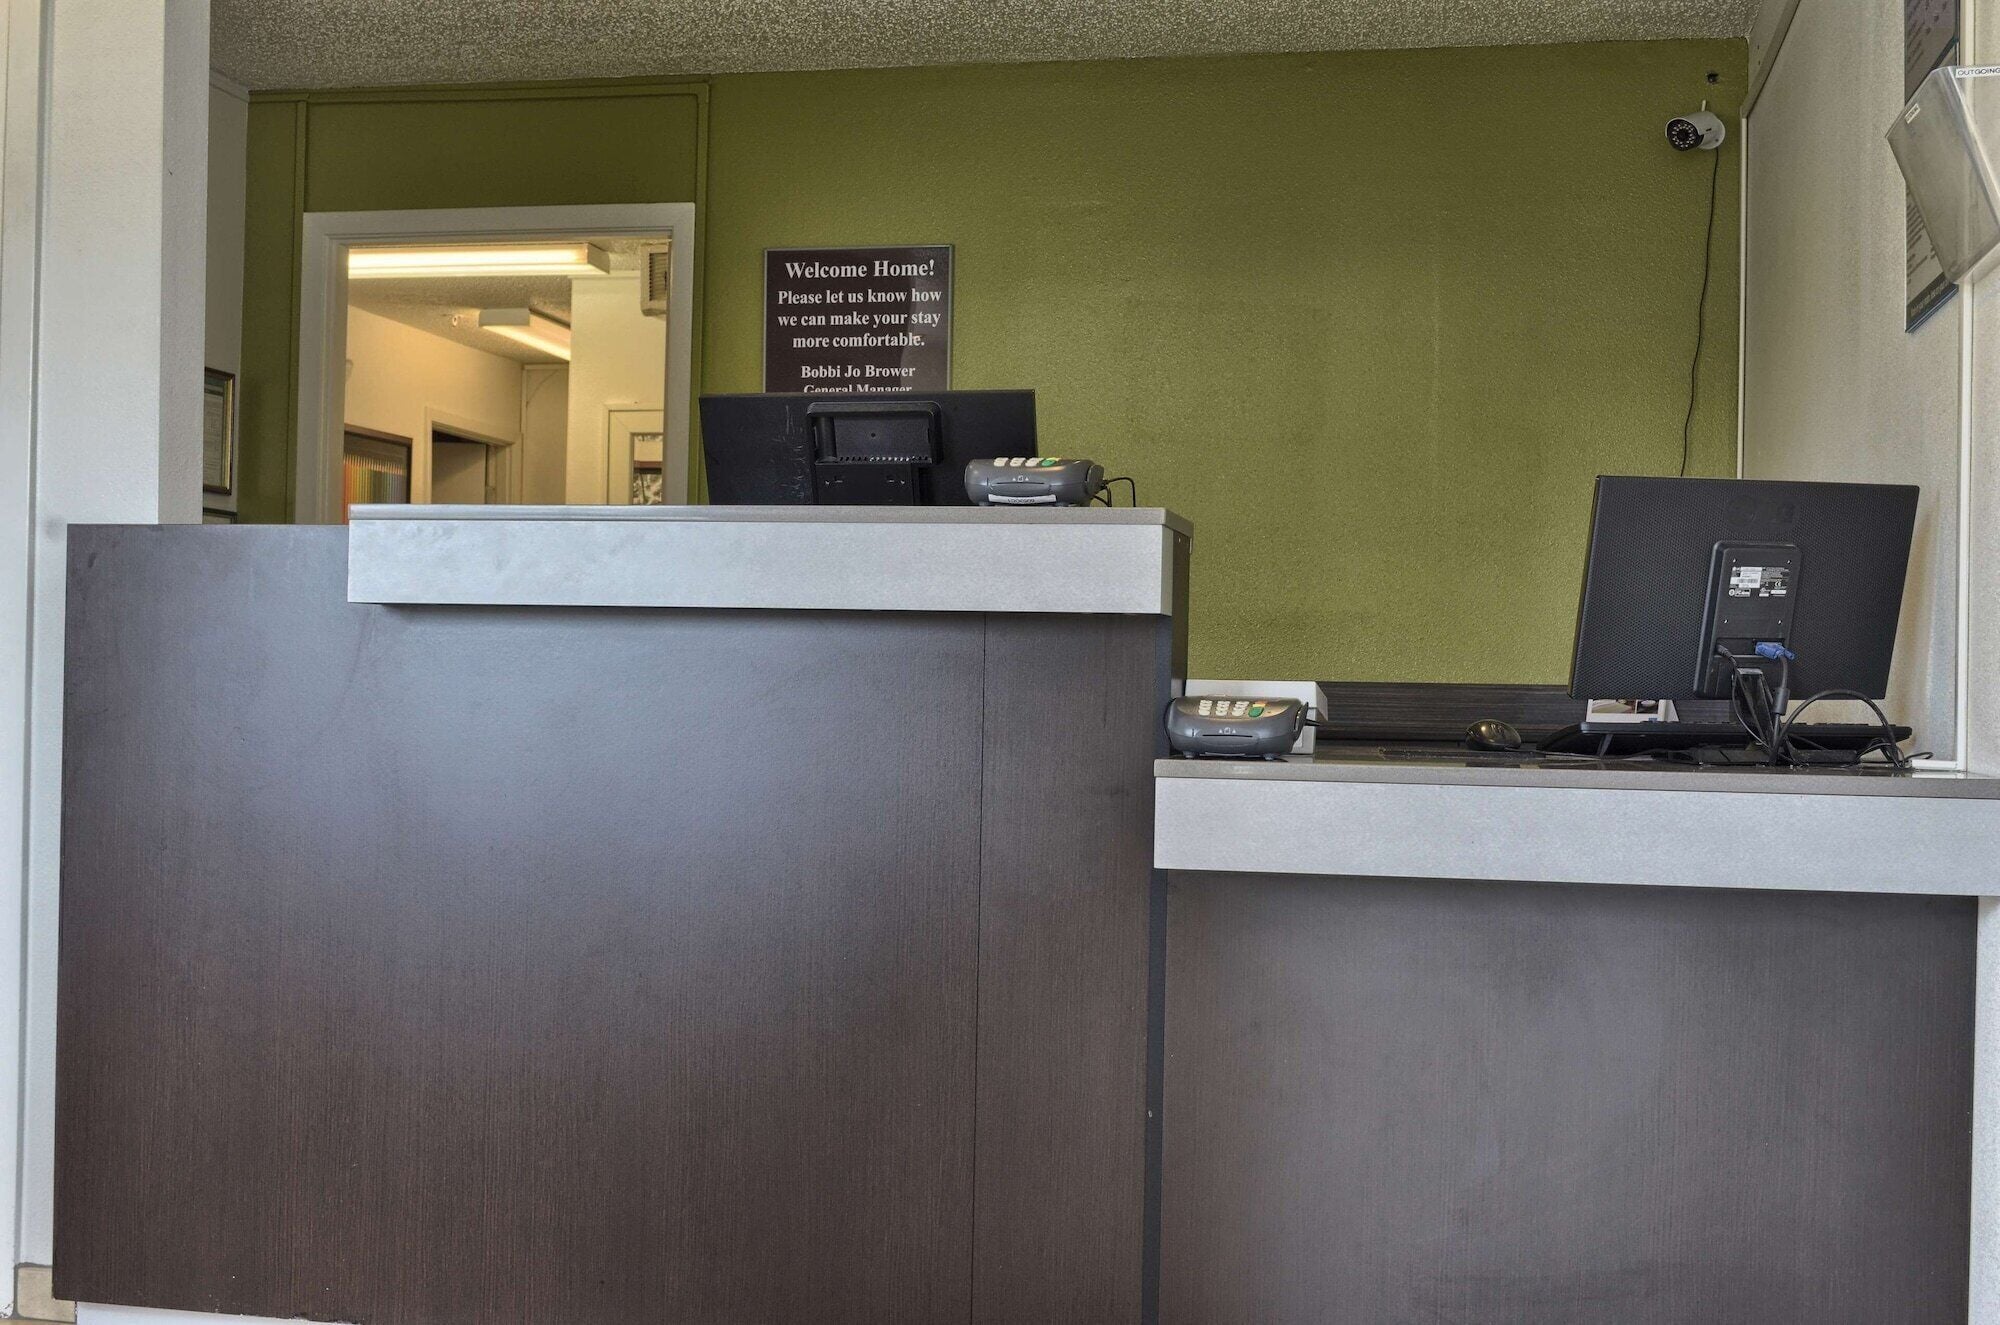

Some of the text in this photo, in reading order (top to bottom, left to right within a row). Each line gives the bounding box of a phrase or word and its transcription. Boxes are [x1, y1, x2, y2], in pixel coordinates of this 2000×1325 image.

[785, 259, 935, 279] Welcome Home!
[778, 288, 942, 305] Please let us know how
[778, 311, 941, 328] we can make your stay
[792, 333, 925, 348] more comfortable.
[801, 364, 916, 378] Bobbi Jo Brower
[803, 384, 852, 393] General
